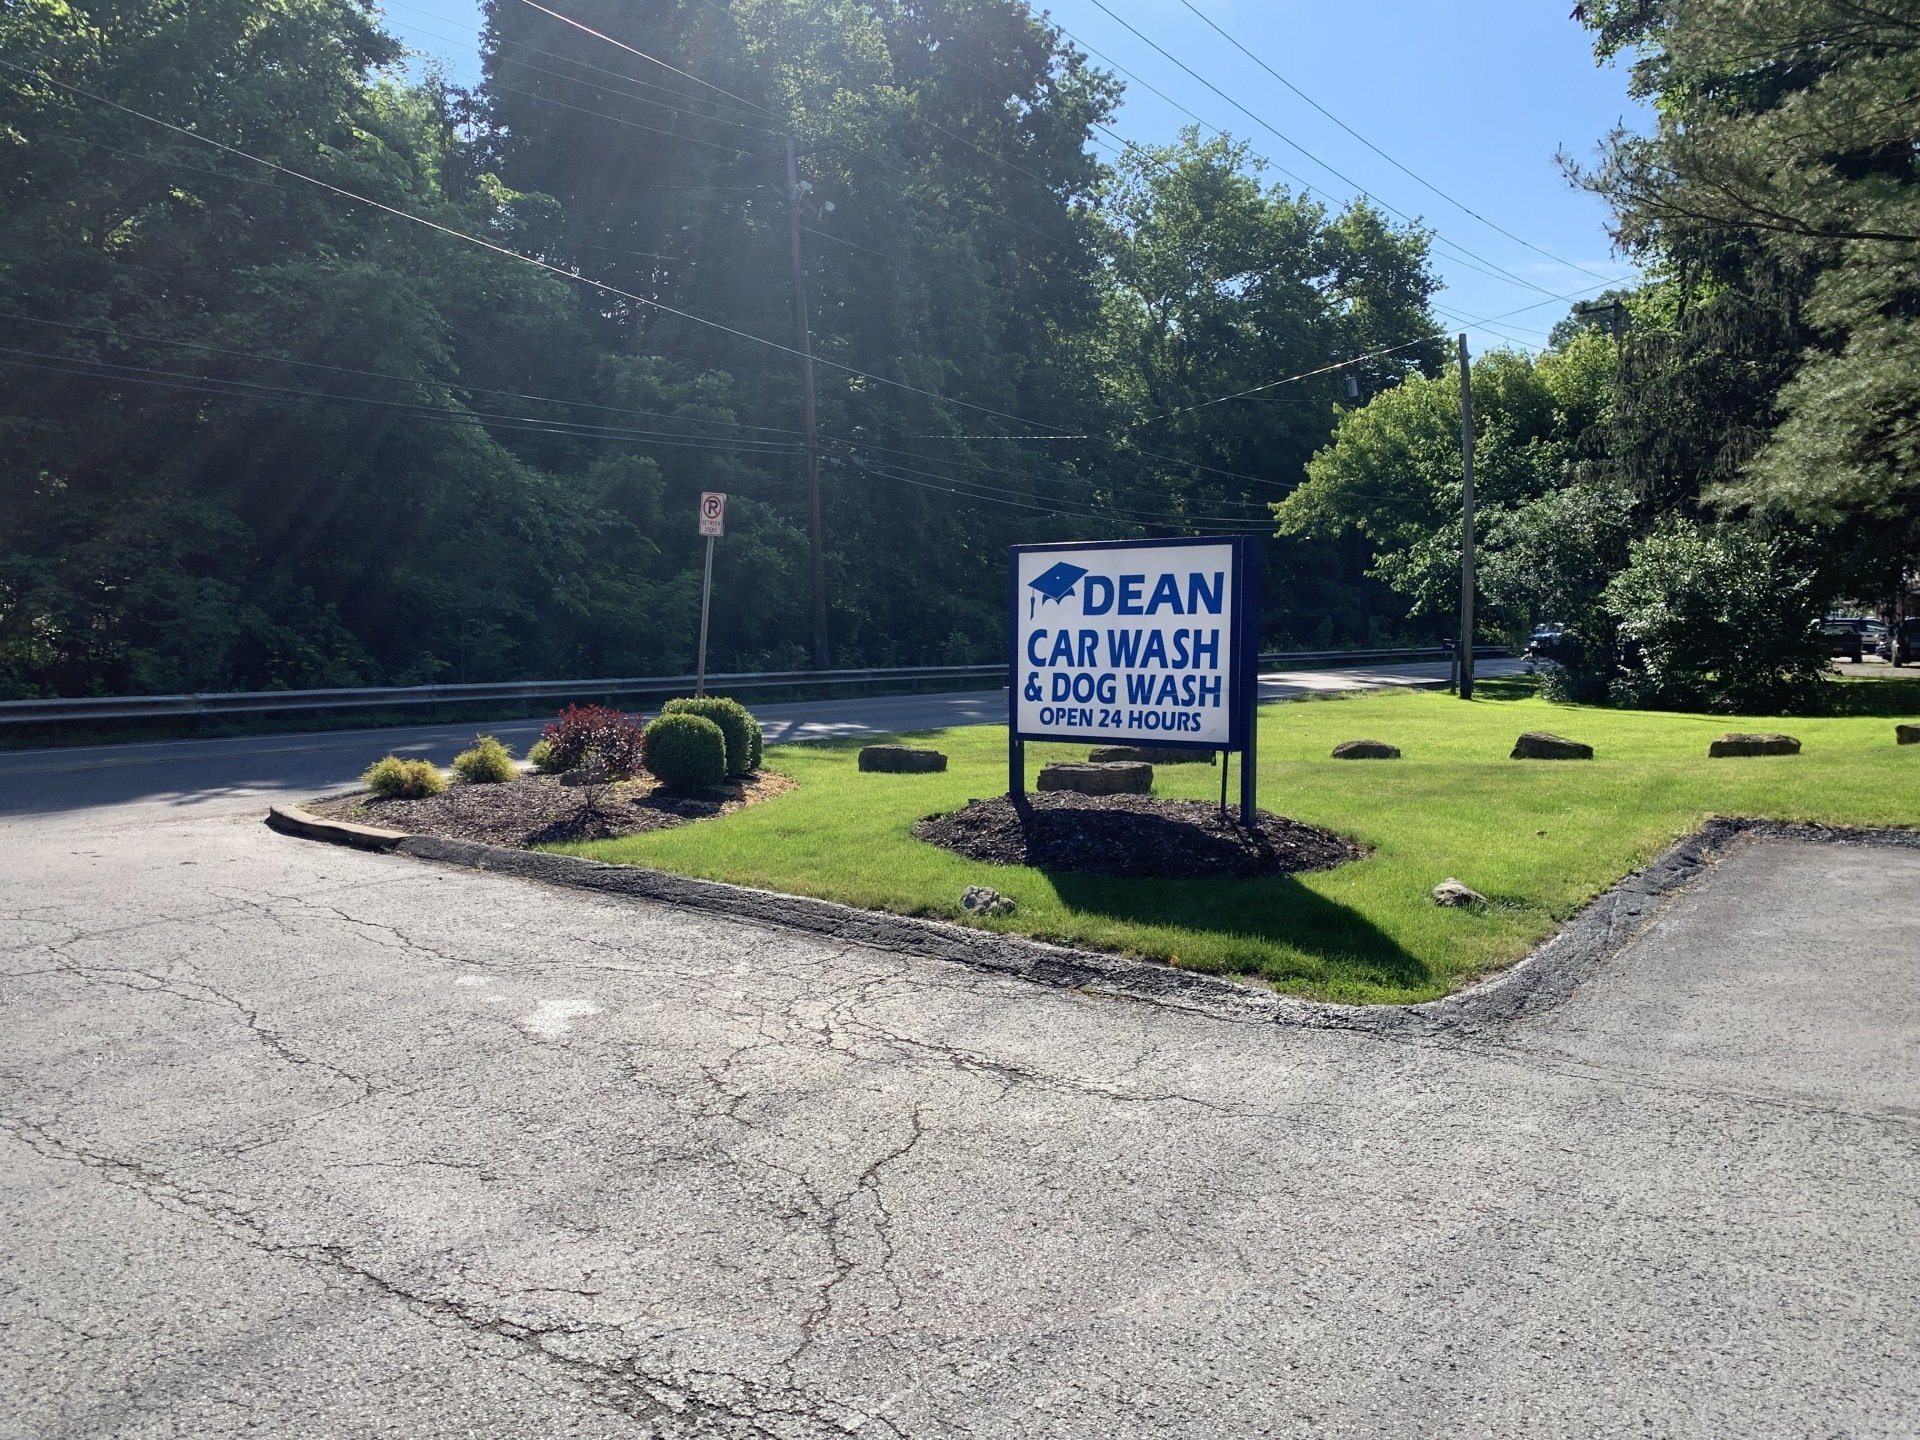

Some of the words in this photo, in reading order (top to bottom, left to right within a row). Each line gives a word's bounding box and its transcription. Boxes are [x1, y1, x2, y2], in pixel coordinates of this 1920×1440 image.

[1082, 572, 1225, 616] DEAN
[1027, 628, 1099, 668] CAR
[1107, 628, 1220, 670] WASH
[1024, 671, 1043, 702] &
[1051, 672, 1117, 704] DOG
[1126, 674, 1222, 708] WASH
[1039, 706, 1093, 727] OPEN
[1098, 709, 1123, 728] 24
[1128, 710, 1202, 732] HOURS
